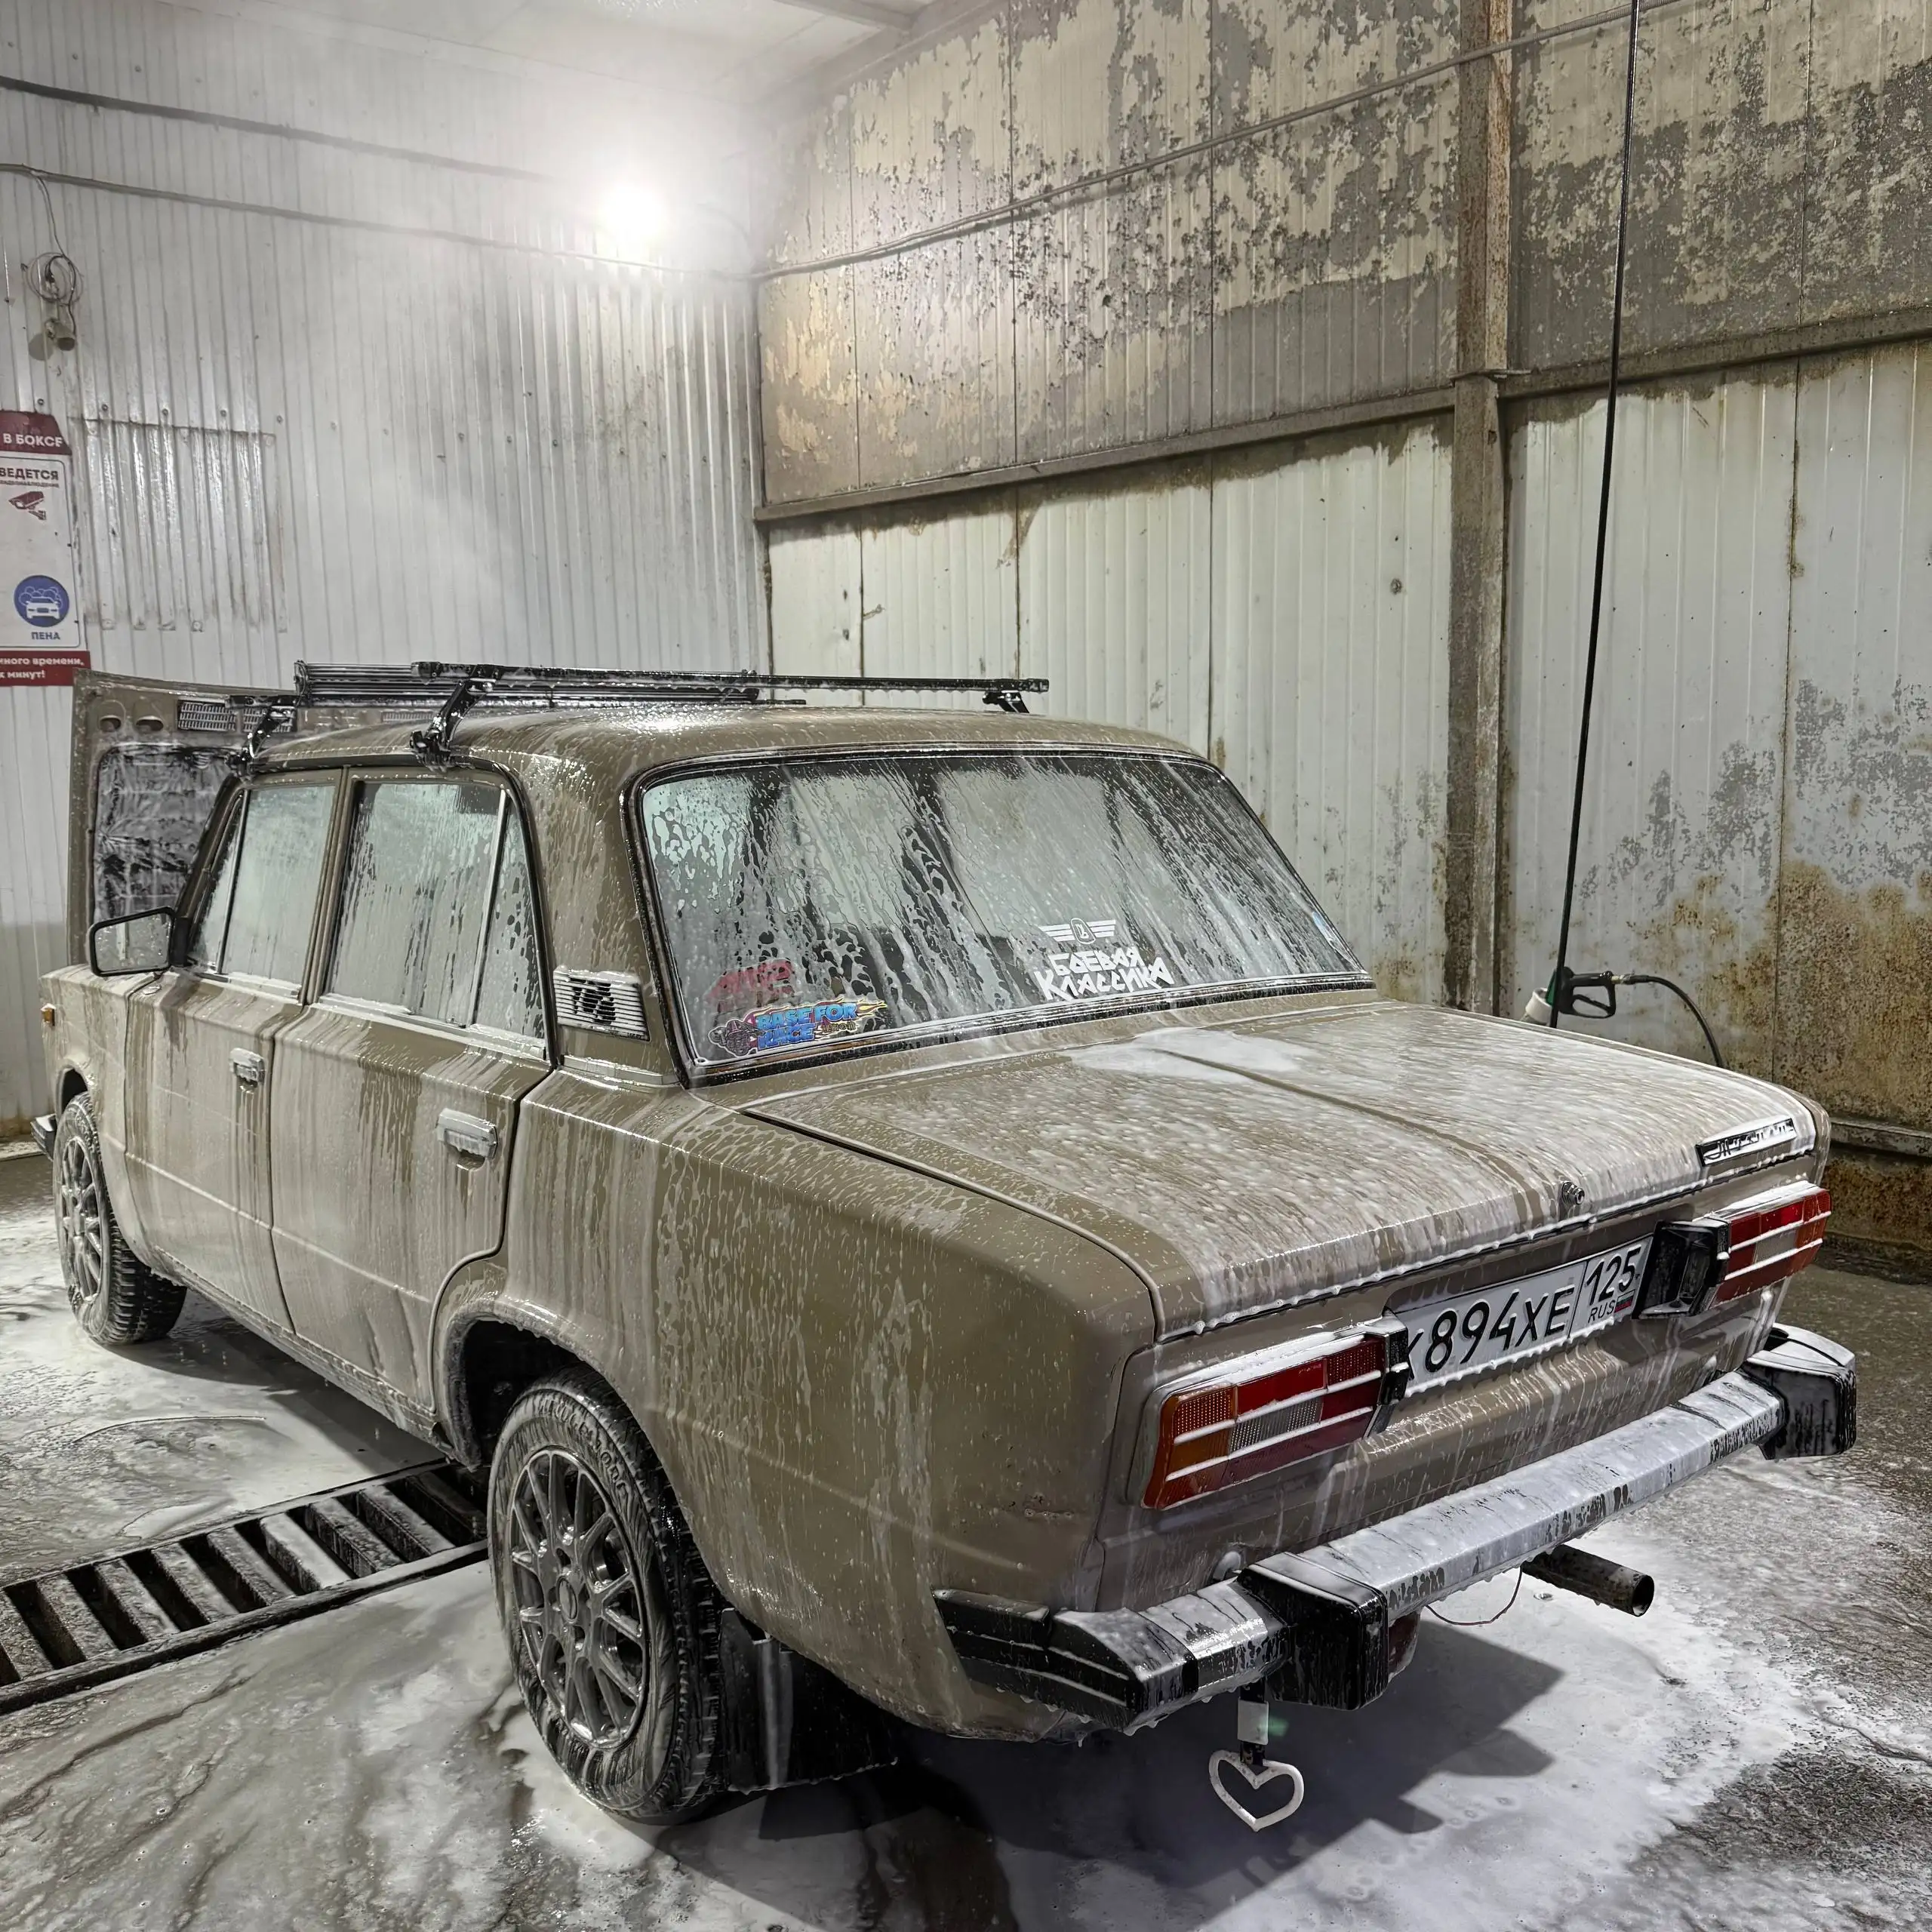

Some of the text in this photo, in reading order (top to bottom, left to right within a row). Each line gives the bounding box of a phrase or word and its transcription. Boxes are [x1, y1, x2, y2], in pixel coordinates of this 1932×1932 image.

[3, 433, 12, 444] В
[0, 468, 58, 480] ВЕДЕТСЯ
[31, 632, 60, 640] ПЕНА
[1034, 956, 1174, 1000] КЛАССИКА
[755, 1008, 812, 1030] BASE
[814, 1003, 857, 1023] FOR
[1586, 1244, 1642, 1306] 125
[1588, 1300, 1616, 1324] RUS
